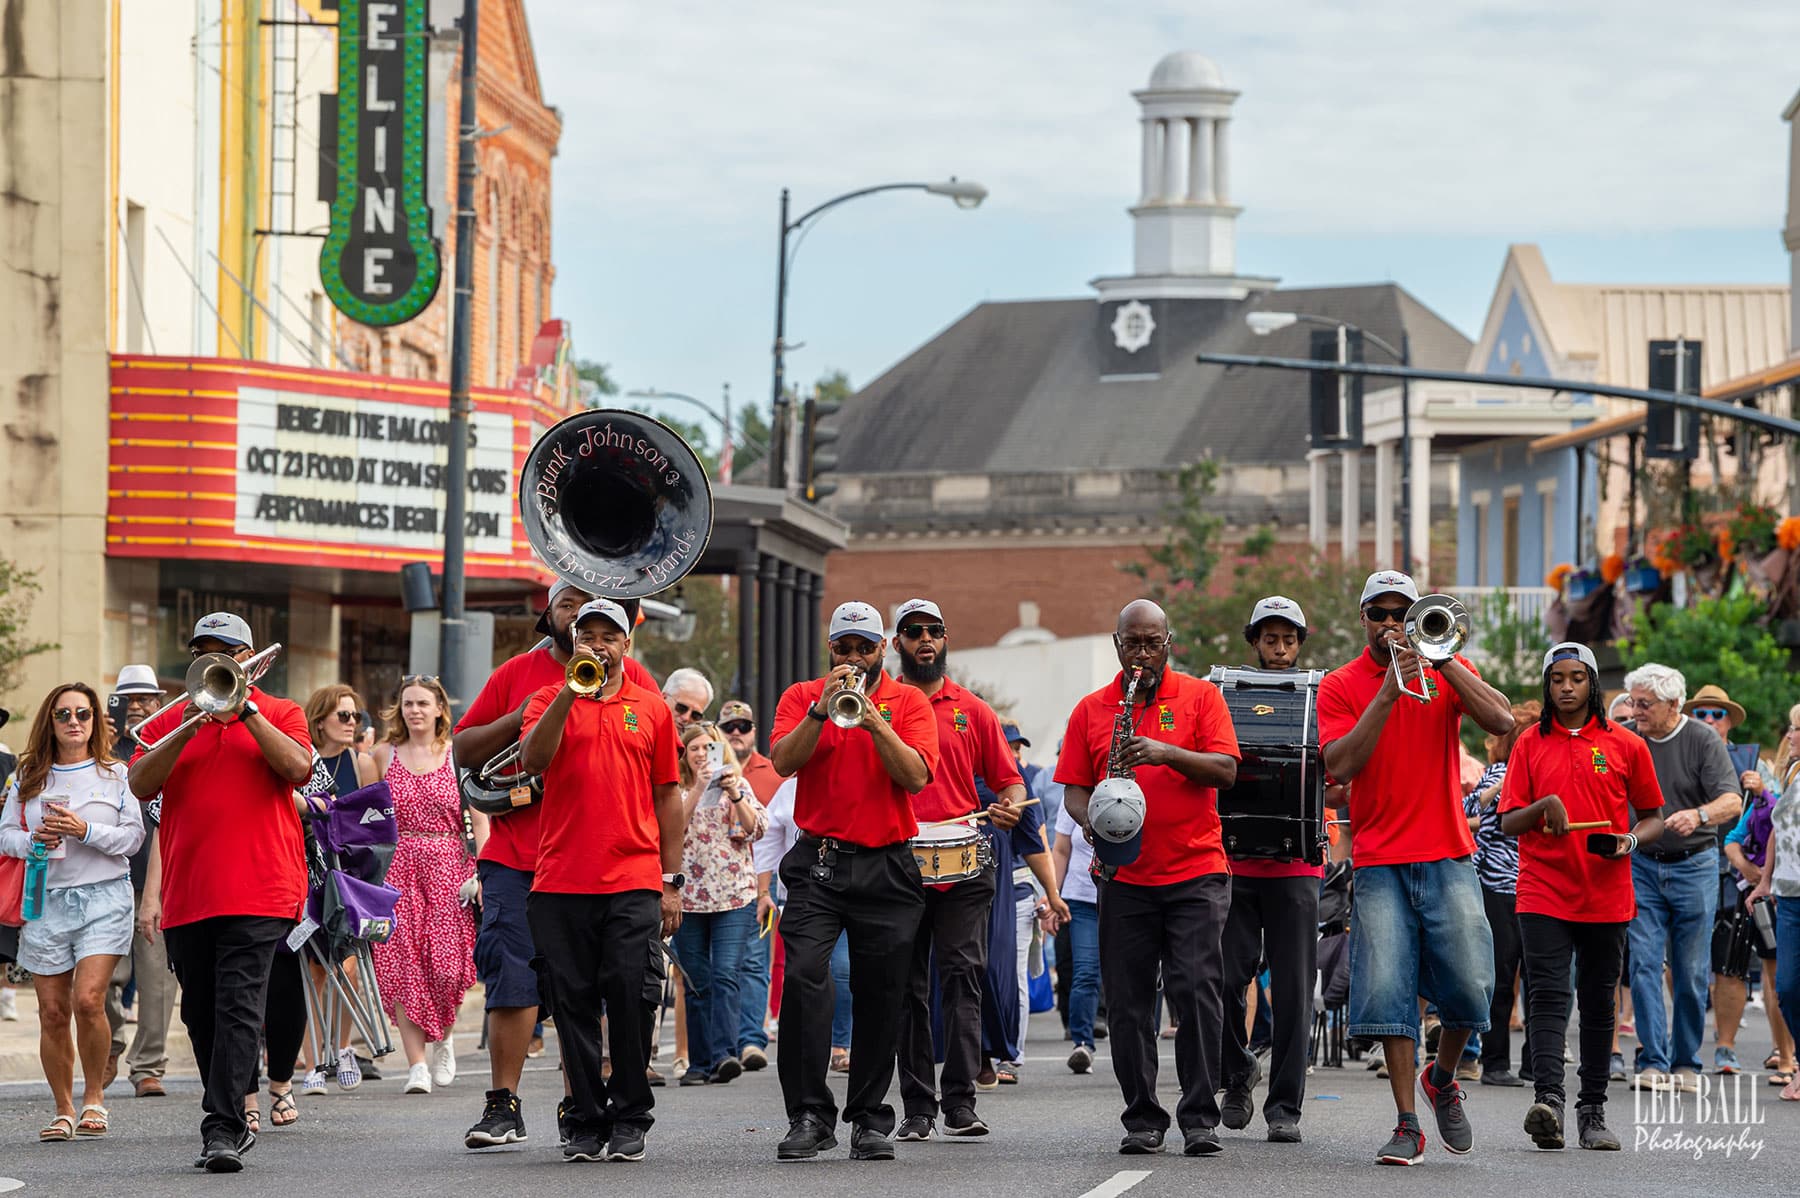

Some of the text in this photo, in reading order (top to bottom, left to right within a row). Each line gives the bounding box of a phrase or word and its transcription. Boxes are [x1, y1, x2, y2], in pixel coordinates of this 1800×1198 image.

[355, 412, 385, 440] THE
[388, 415, 477, 449] BALCONS
[247, 446, 507, 494] OCT 23 FOOD AT 12PM SHOWS
[536, 422, 669, 502] Bunk Johnson
[555, 534, 692, 590] Brazz Band
